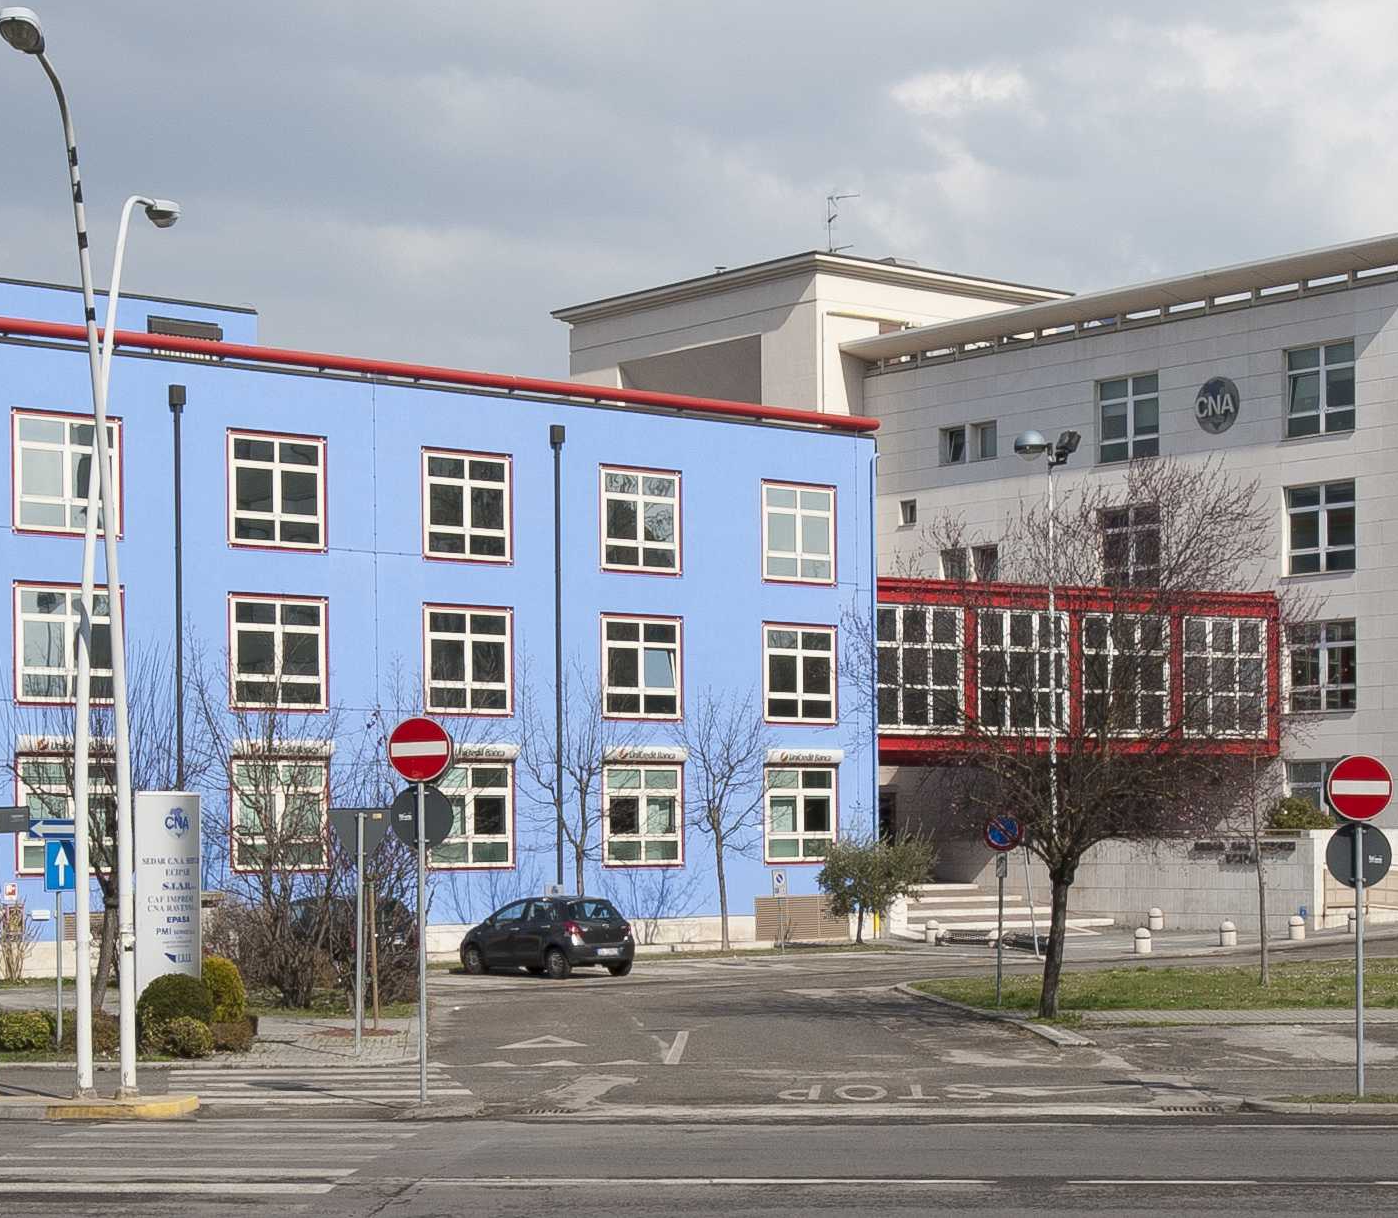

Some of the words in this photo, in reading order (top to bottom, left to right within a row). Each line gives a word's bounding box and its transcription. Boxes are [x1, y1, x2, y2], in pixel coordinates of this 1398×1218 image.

[1195, 393, 1235, 419] CNA
[165, 816, 189, 830] CNA
[776, 1083, 995, 1102] STOP
